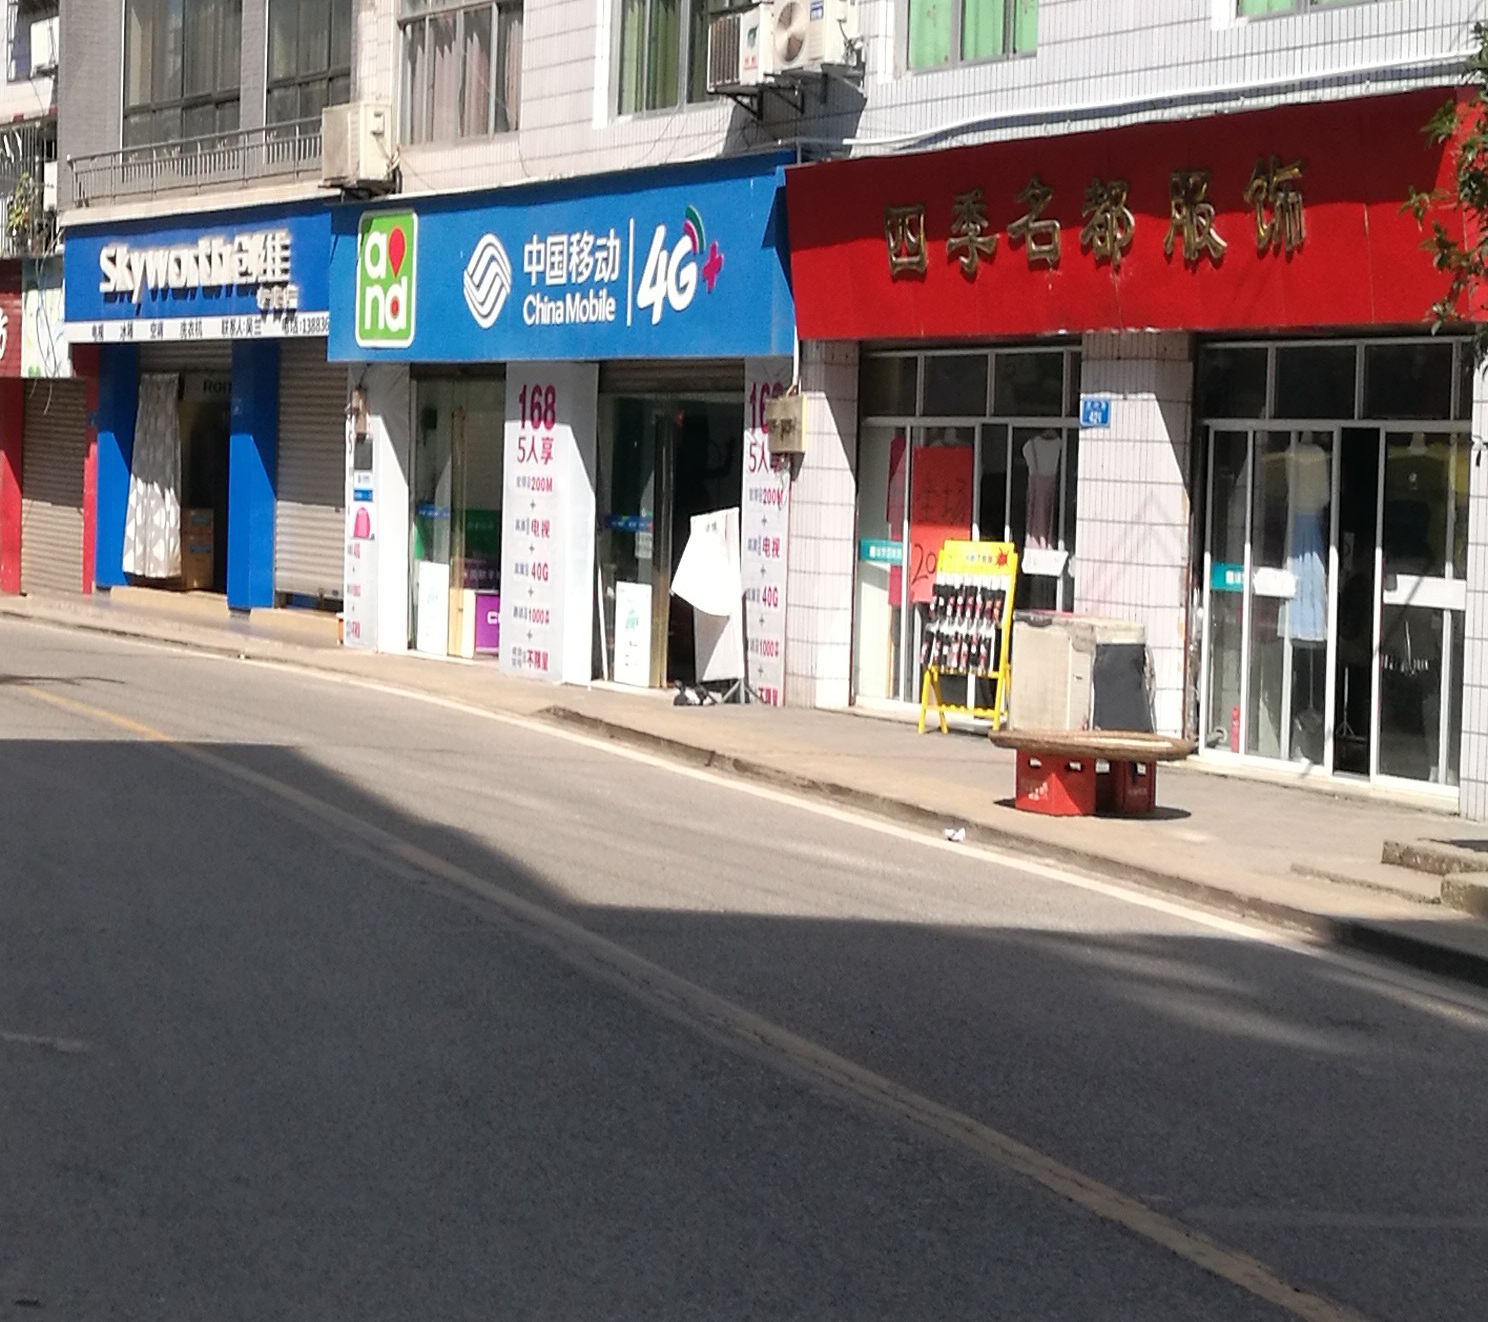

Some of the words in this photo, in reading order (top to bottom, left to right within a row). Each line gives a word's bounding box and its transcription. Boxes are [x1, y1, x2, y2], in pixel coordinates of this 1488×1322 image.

[884, 156, 1307, 280] 四季名都服饰
[523, 229, 621, 286] 中国移动
[519, 383, 556, 430] 168
[517, 435, 554, 465] 5人享
